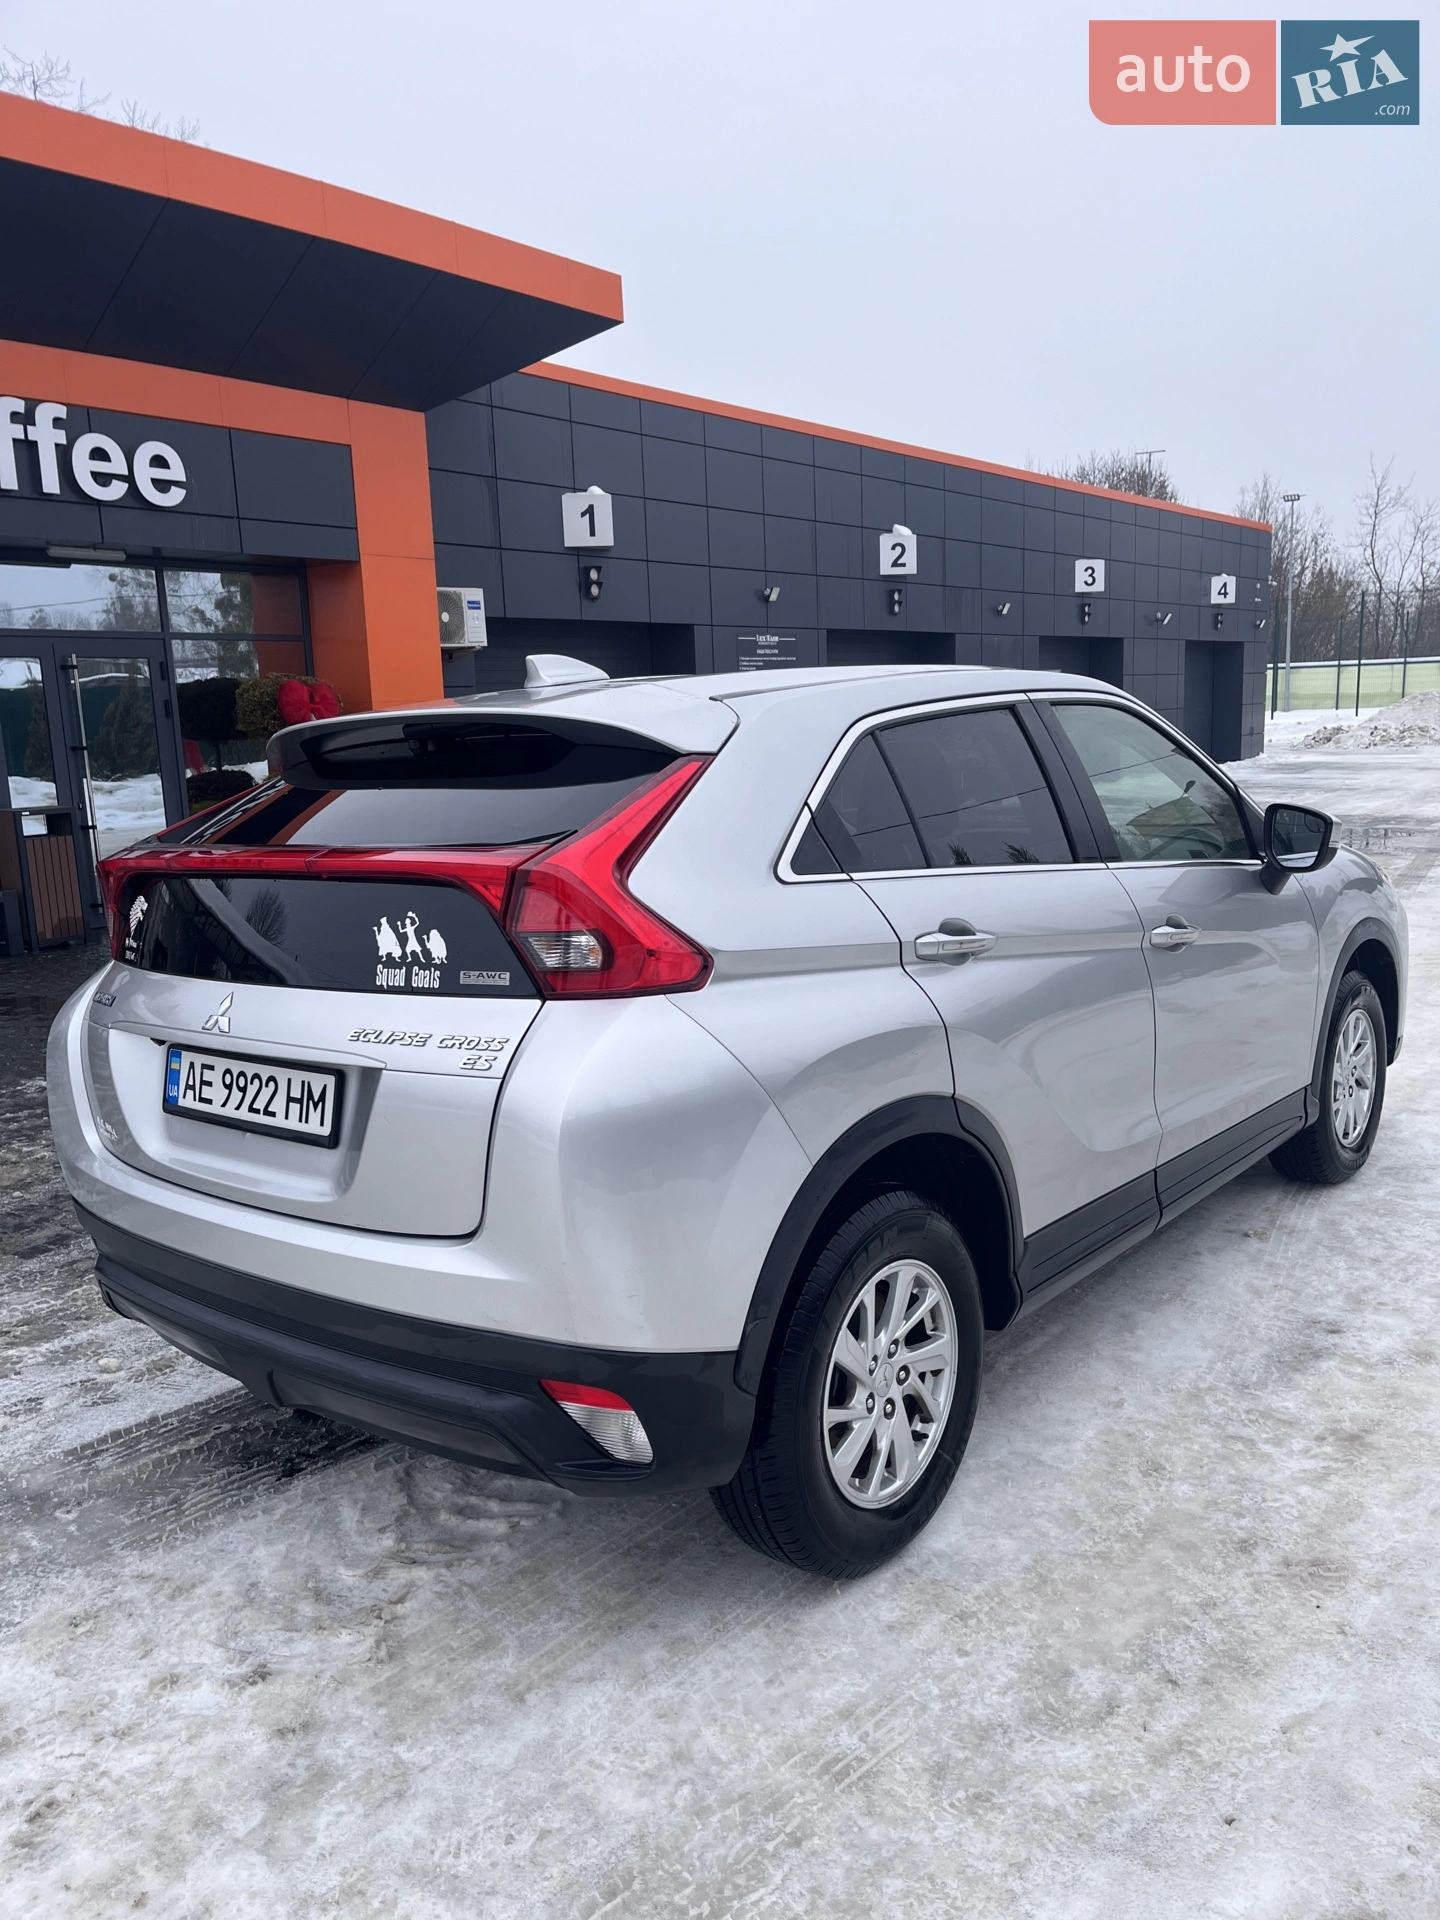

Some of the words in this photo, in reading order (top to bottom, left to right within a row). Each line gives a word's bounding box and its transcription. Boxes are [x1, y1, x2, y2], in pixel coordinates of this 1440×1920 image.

[580, 504, 596, 537] 1
[890, 542, 907, 568] 2
[1083, 566, 1096, 586] 3
[1217, 582, 1229, 599] 4
[376, 964, 406, 989] Squad
[412, 966, 440, 988] Goals
[462, 971, 507, 980] S-AWC
[347, 1028, 433, 1047] ECLIPSE
[437, 1035, 510, 1052] CROSS
[459, 1054, 498, 1071] ES
[169, 1084, 178, 1097] UA
[182, 1061, 215, 1106] AE
[220, 1068, 279, 1118] 9922
[284, 1078, 327, 1127] HM
